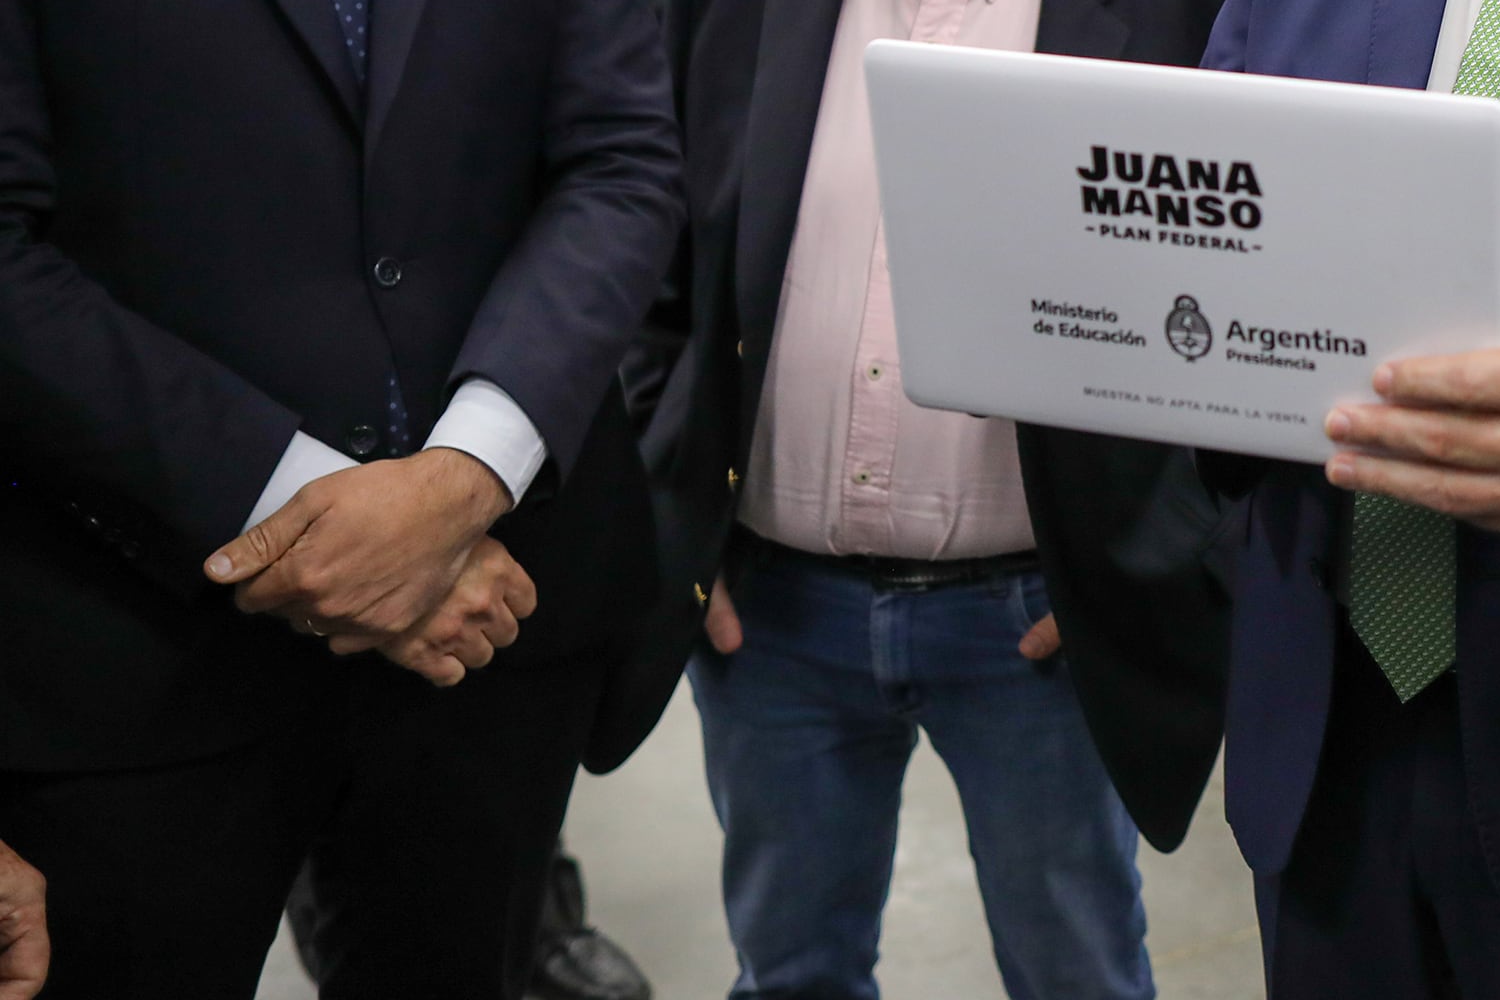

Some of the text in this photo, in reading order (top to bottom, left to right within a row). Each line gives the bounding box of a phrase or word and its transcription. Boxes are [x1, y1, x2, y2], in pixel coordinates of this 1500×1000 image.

[1077, 145, 1262, 197] JUANA
[1080, 184, 1262, 231] MANSO
[1100, 223, 1249, 254] PLAN FEDERAL
[1030, 299, 1118, 324] Ministerio
[1033, 319, 1147, 348] de Educación
[1226, 319, 1368, 357] Argentina
[1225, 348, 1317, 373] Presidencia
[1169, 398, 1200, 411] APTA
[1206, 403, 1240, 417] PARA
[1245, 409, 1260, 420] LA
